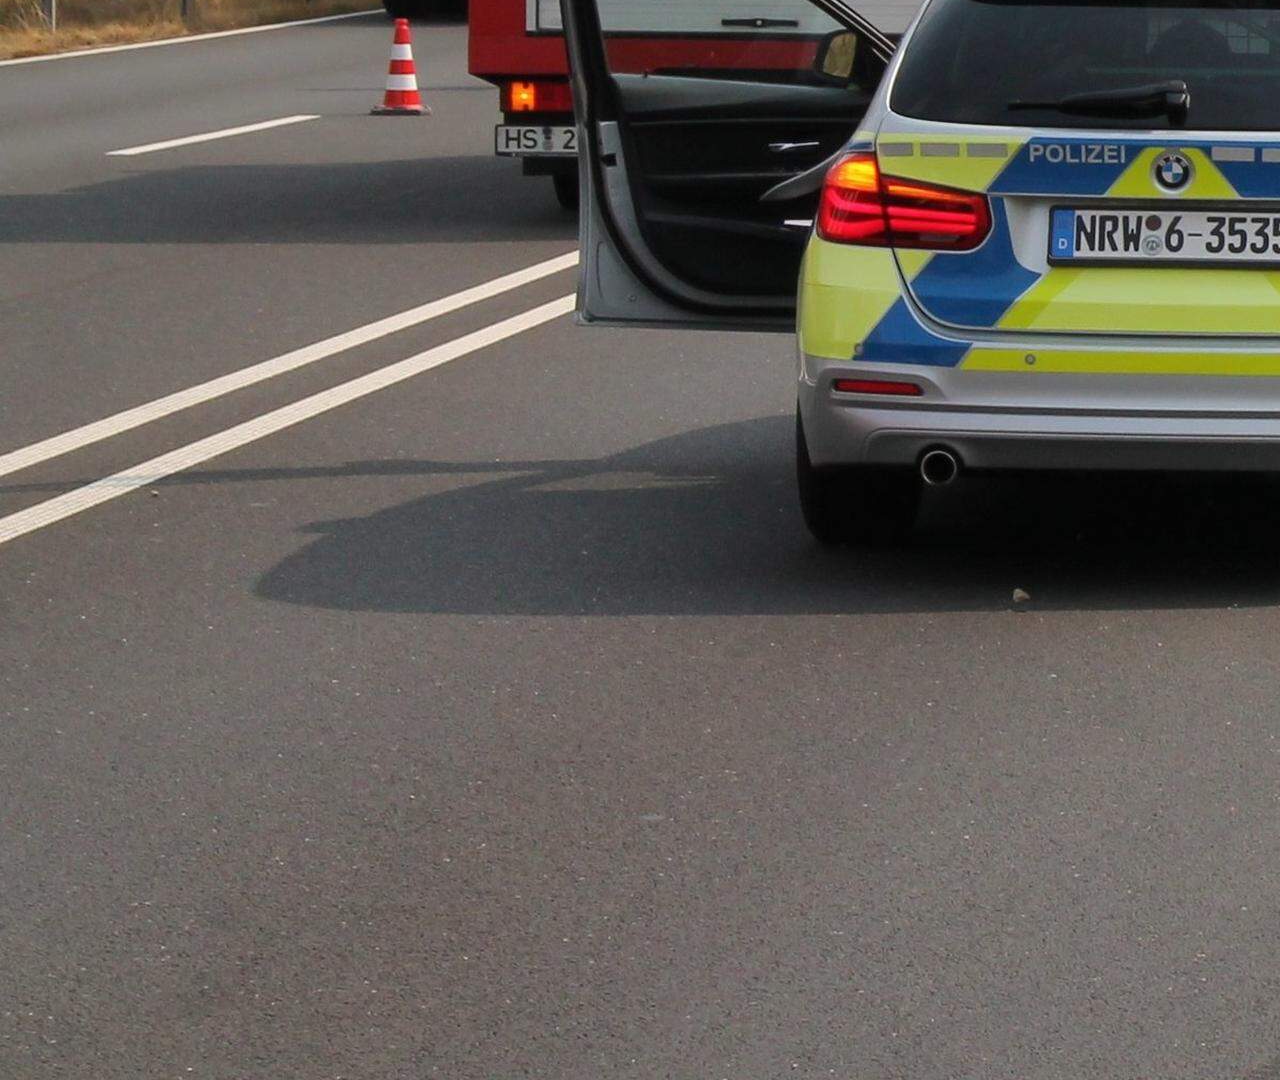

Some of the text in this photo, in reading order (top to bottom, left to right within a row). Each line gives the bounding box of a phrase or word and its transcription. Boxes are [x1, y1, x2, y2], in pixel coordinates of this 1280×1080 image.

[505, 128, 577, 150] HS 2
[1029, 143, 1126, 164] POLIZEI
[1058, 239, 1068, 249] D
[1075, 214, 1143, 252] NRW
